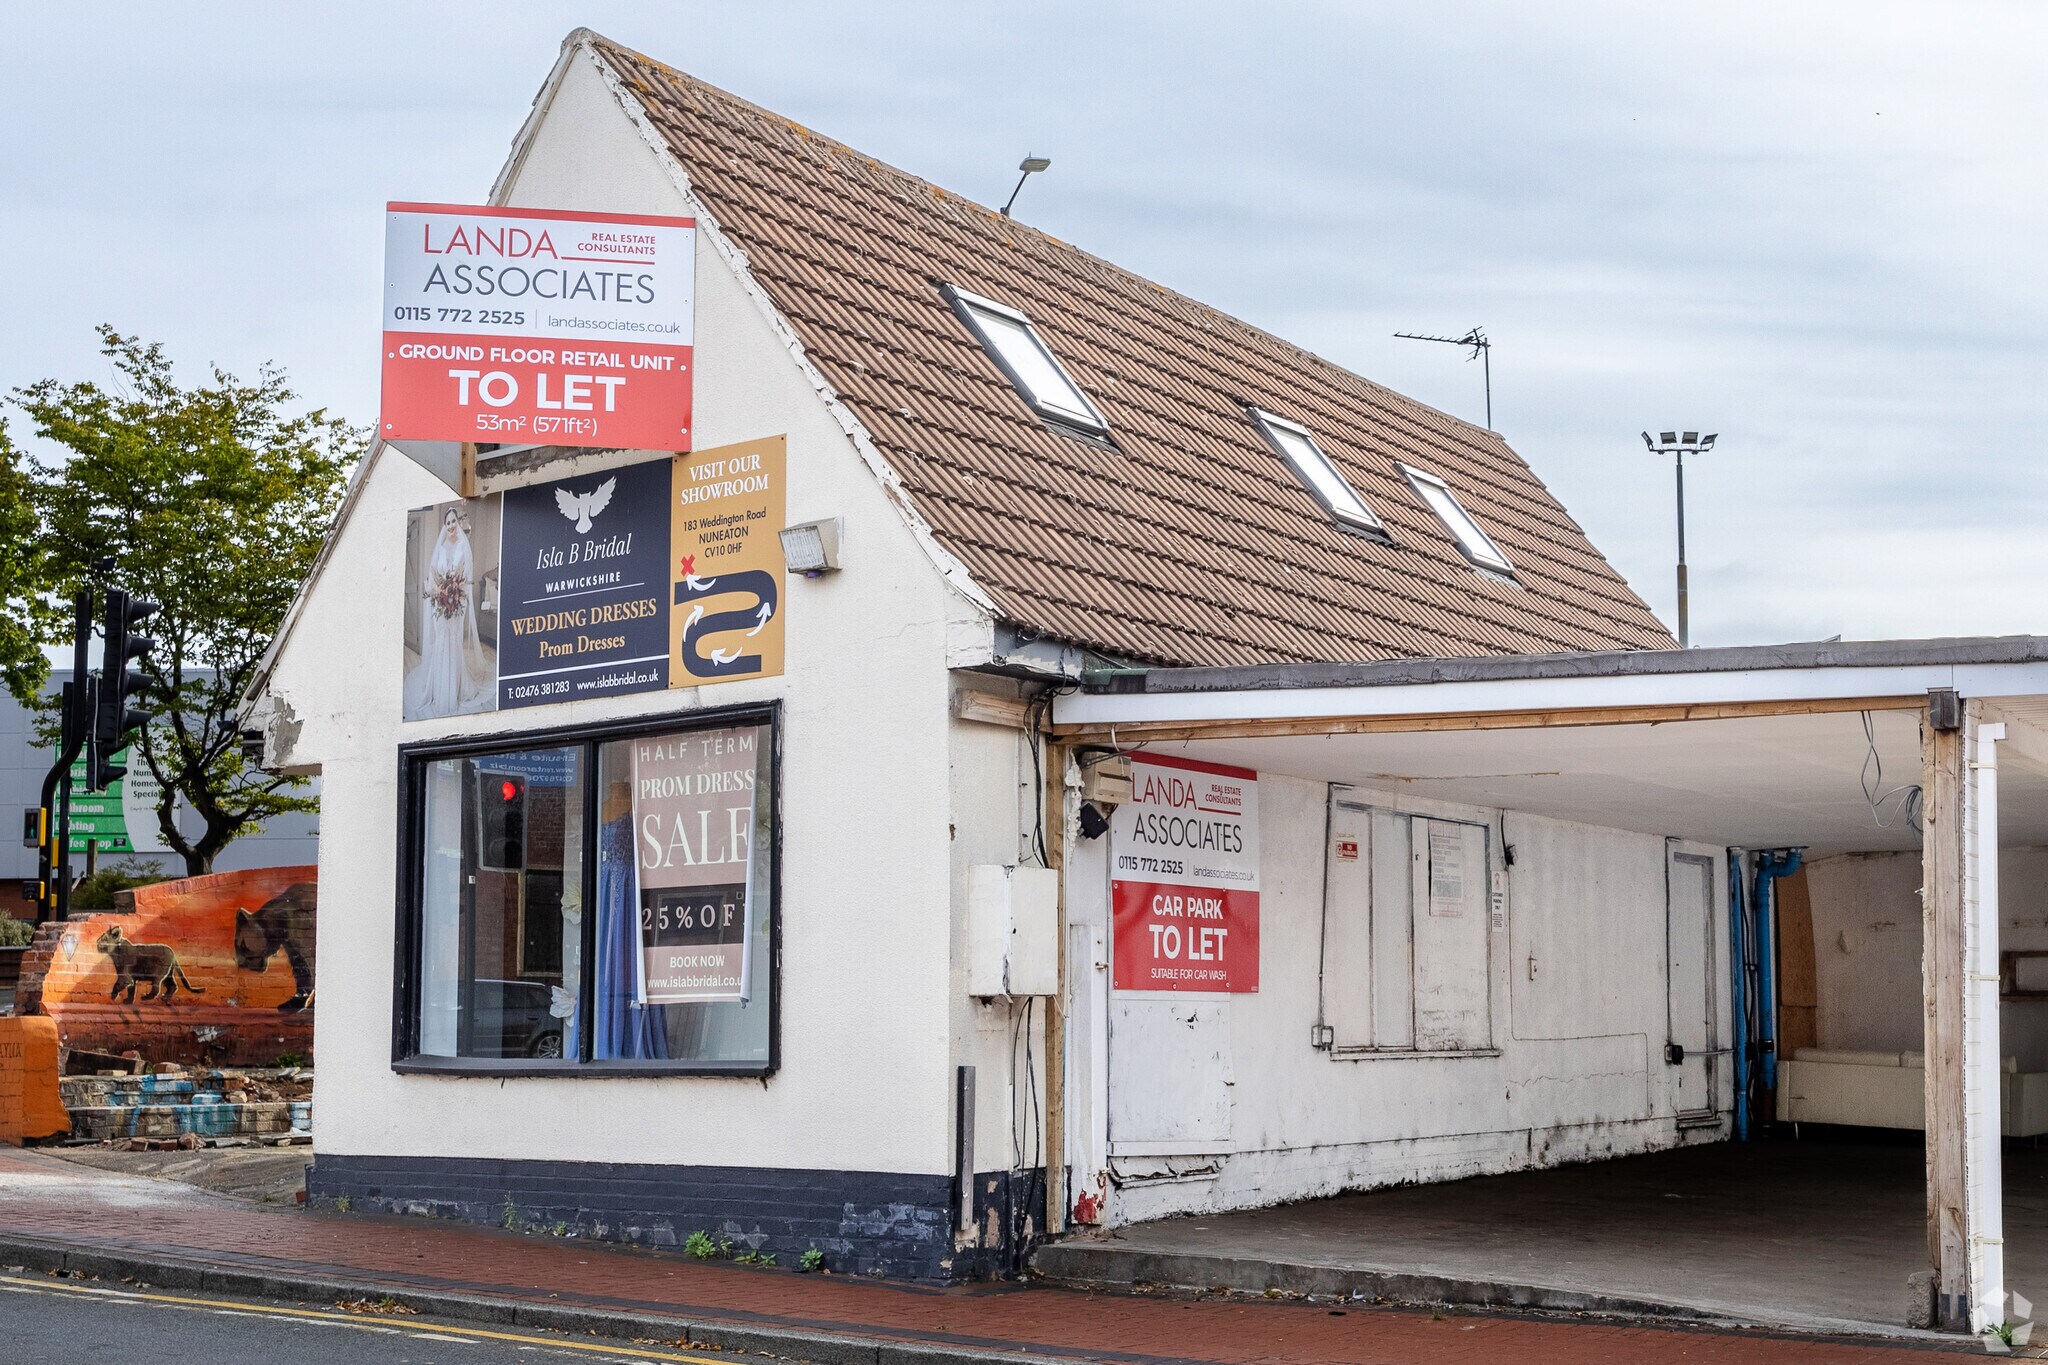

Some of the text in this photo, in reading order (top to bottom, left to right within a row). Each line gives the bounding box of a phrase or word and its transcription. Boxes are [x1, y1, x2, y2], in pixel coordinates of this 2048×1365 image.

[424, 223, 558, 260] LANDA
[577, 243, 656, 255] CONSULTANTS
[592, 232, 656, 244] REAL ESTATE
[422, 262, 655, 304] ASSOCIATES
[394, 306, 525, 325] 0115 772 2525
[548, 315, 680, 334] landassociates.co.uk
[399, 343, 675, 371] GROUND FLOOR RETAIL UNIT
[448, 369, 626, 411] TO LET
[689, 454, 761, 482] VISIT OUR
[681, 474, 769, 505] SHOWROOM
[684, 506, 766, 531] 183 Weddington Road
[699, 526, 749, 544] NUNEATON
[536, 533, 632, 570] Isla B Bridal
[704, 545, 725, 558] CV10
[545, 571, 621, 593] WARWICKSHIRE
[511, 598, 657, 636] WEDDING DRESSES
[539, 635, 625, 658] Prom Dresses
[508, 668, 659, 699] T: 02476 381283 www.islabbridal.co.uk
[640, 735, 753, 762] HALF TERM
[131, 780, 160, 788] Homew
[133, 769, 164, 777] Numr
[640, 769, 755, 800] PROM DRESS
[1131, 772, 1197, 810] LANDA
[1205, 793, 1242, 807] CONSULTANTS
[1211, 784, 1242, 796] REAL ESTATE
[642, 806, 751, 869] SALE
[1133, 812, 1243, 854] ASSOCIATES
[1118, 855, 1183, 875] 0115 772 2525
[1193, 865, 1255, 881] landassociates.co.uk
[700, 904, 745, 928] OF
[1152, 894, 1224, 920] CAR PARK
[1148, 924, 1228, 961] TO LET
[670, 955, 725, 968] BOOK NOW
[647, 975, 742, 988] www.islabbridal.co.u
[1151, 968, 1227, 980] SUITABLE FOR CAR WASH
